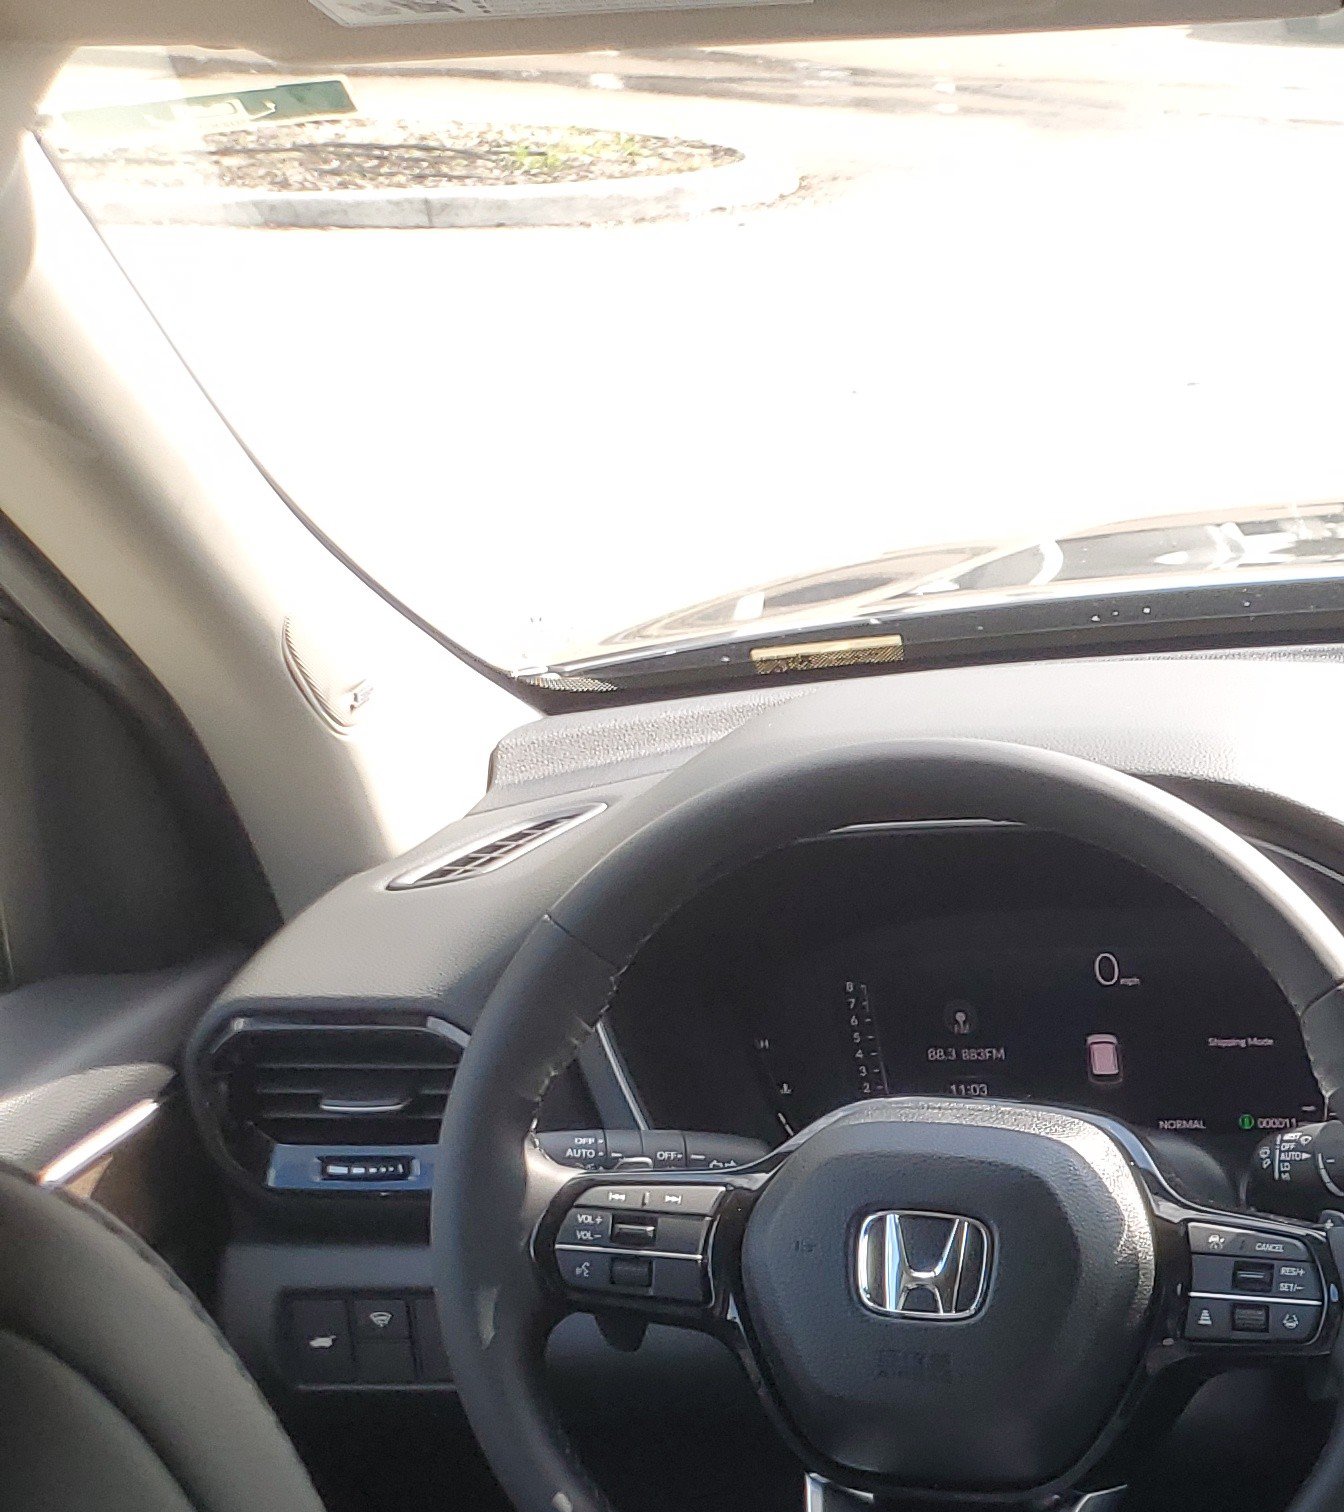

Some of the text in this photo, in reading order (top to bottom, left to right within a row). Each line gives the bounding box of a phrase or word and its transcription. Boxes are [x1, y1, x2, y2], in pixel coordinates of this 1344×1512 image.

[1093, 952, 1119, 986] 0
[949, 1083, 989, 1097] 11:03
[1158, 1118, 1207, 1130] NORMAL
[565, 1147, 596, 1158] AUTO
[656, 1151, 677, 1161] OFF
[1280, 1151, 1302, 1161] AUTO
